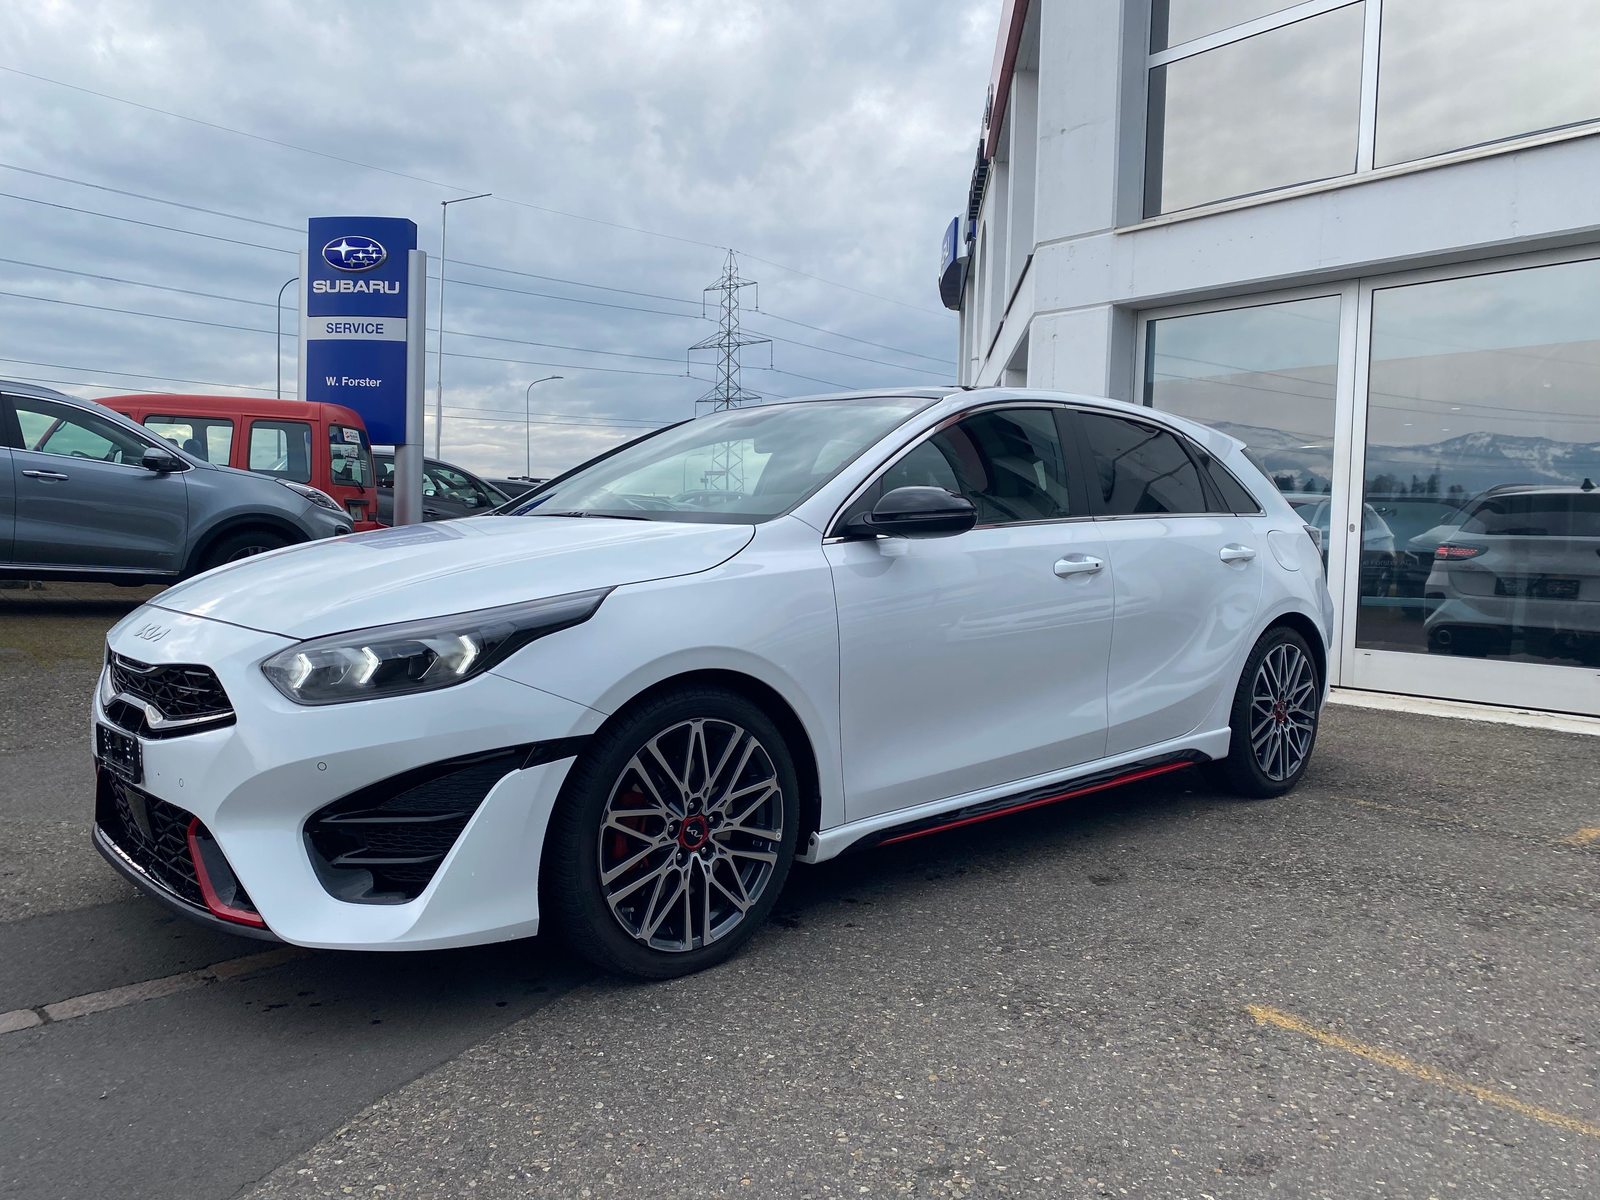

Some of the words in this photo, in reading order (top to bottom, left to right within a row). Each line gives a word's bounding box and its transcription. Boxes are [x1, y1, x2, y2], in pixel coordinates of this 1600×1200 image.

[312, 280, 400, 294] SUBARU
[326, 323, 384, 334] SERVICE
[325, 376, 339, 387] W.
[341, 376, 382, 388] Forster
